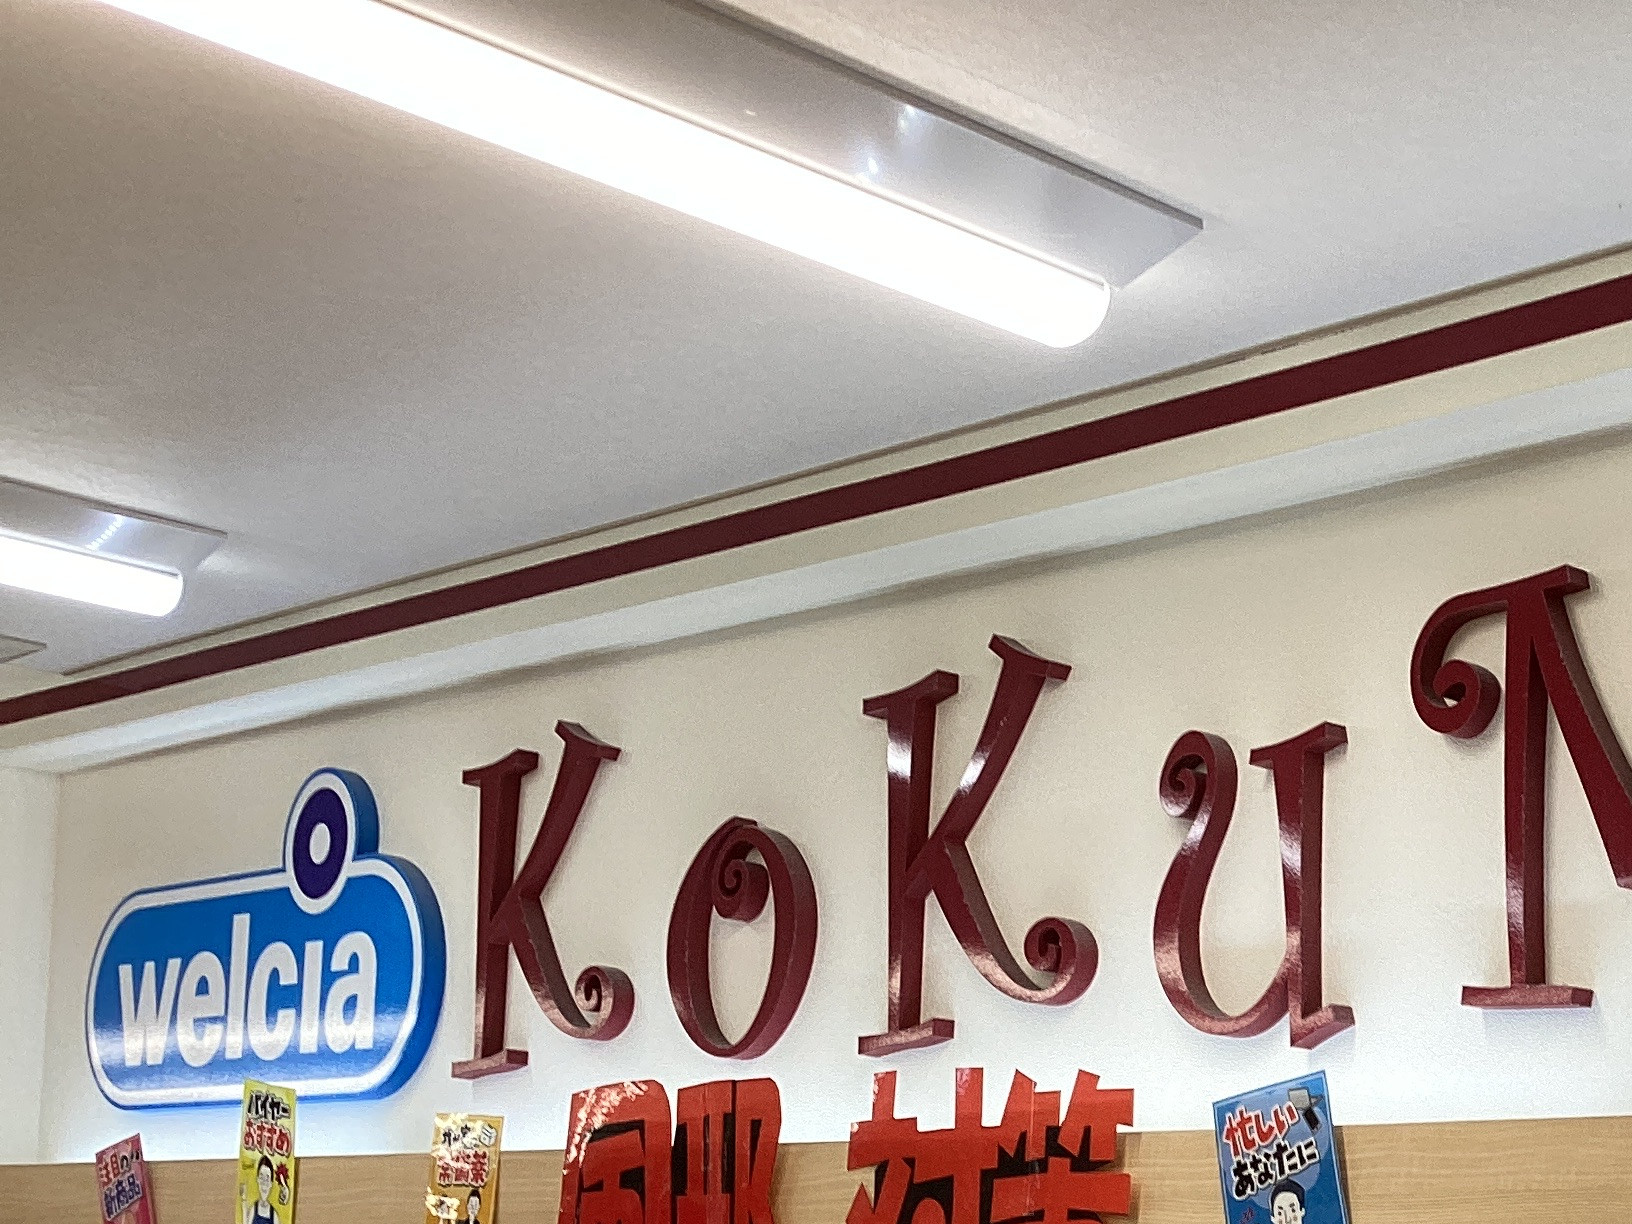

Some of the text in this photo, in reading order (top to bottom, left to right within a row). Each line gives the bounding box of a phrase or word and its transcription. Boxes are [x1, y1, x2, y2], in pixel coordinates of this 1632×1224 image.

[117, 912, 377, 1067] welcia
[247, 1089, 291, 1122] バイヤー
[1222, 1102, 1297, 1159] 忙しい
[243, 1120, 291, 1156] おすすめ
[1230, 1139, 1318, 1200] あなたに
